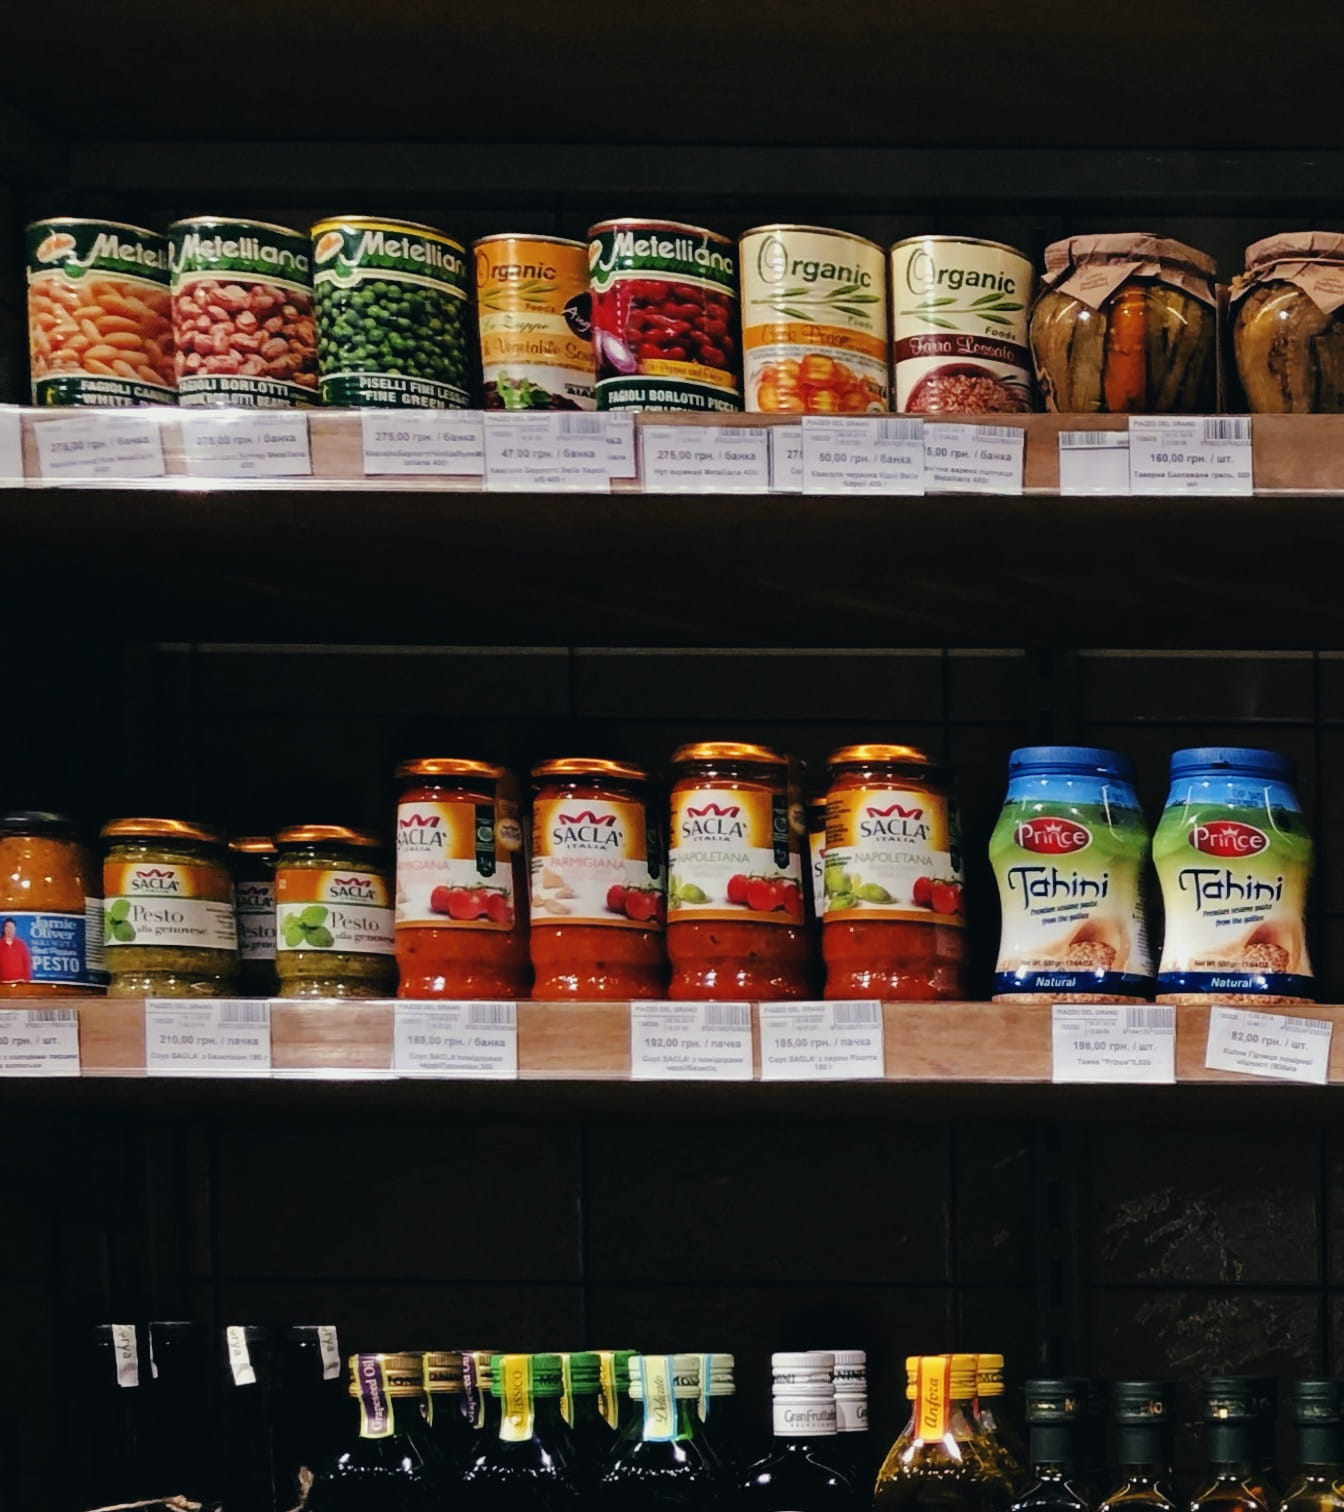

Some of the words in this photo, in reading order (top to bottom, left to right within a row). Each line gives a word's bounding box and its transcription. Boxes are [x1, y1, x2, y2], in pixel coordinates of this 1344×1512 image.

[172, 232, 310, 271] Metelliana
[604, 231, 734, 274] Metelliana
[758, 237, 872, 289] Organic
[475, 250, 557, 289] Organic
[908, 247, 1016, 294] Organic
[219, 380, 287, 396] BORLOTTI
[359, 377, 402, 392] PISELLI
[365, 390, 398, 403] FINE
[609, 389, 642, 404] FAGIOLI
[648, 389, 702, 407] BORLOTTI
[1018, 824, 1086, 850] Prince
[1196, 824, 1267, 852] Prince
[678, 851, 750, 864] NAPOLETANA
[1008, 868, 1108, 910] Tahini
[1179, 868, 1282, 911] Tahini
[132, 903, 185, 923] Pesto
[331, 910, 380, 930] Pesto
[33, 956, 80, 973] PESTO
[1036, 977, 1077, 987] Natural
